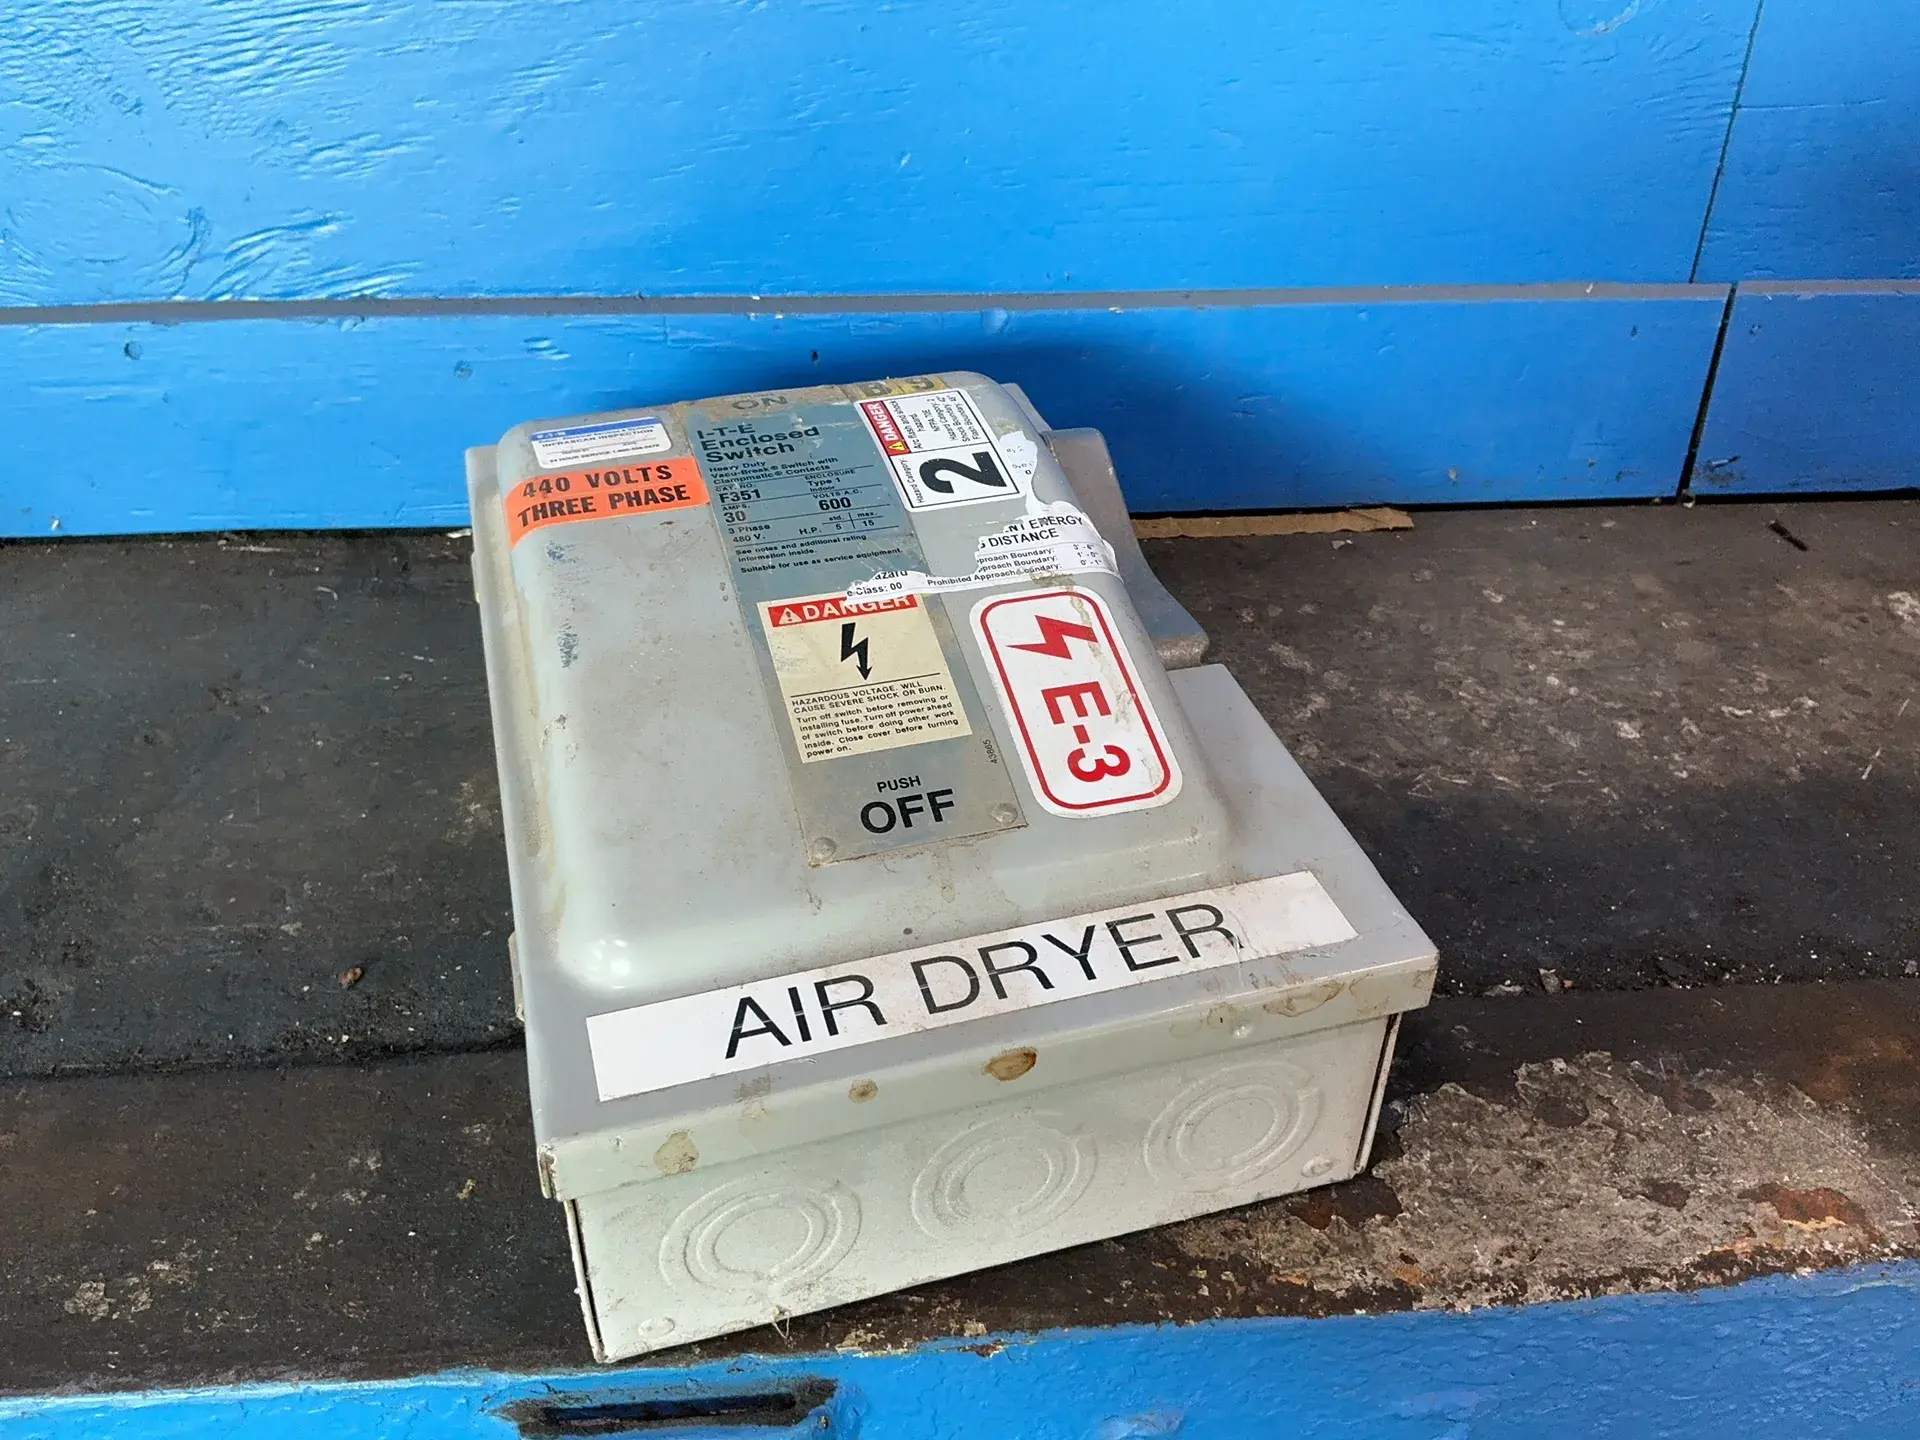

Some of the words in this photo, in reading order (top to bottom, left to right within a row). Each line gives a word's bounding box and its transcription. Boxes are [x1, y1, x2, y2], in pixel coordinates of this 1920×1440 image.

[731, 396, 788, 409] ON
[886, 400, 903, 414] shock
[867, 402, 899, 442] DANGER
[895, 414, 909, 425] and
[926, 418, 941, 432] NFPA
[598, 429, 654, 440] INSPECTION
[697, 423, 756, 440] I-T-E
[701, 426, 820, 451] Enclosed
[902, 425, 917, 438] flash
[941, 423, 958, 441] Hazard
[955, 426, 970, 441] Shock
[966, 425, 981, 439] Flash
[909, 438, 923, 449] Arc
[706, 442, 795, 463] Switch
[709, 463, 739, 473] Heavy
[742, 461, 766, 469] Duty
[781, 460, 815, 470] Switch
[817, 457, 838, 465] with
[785, 465, 831, 475] Contacts
[900, 457, 916, 483] Category:
[804, 469, 856, 480] ENCLOSURE
[919, 451, 1007, 494] 2
[522, 477, 570, 498] 440
[585, 465, 672, 489] VOLTS
[807, 479, 832, 487] Type
[719, 489, 761, 503] F351
[908, 483, 926, 503] Hazard
[517, 496, 597, 528] THREE
[608, 484, 691, 510] PHASE
[818, 497, 852, 511] 600
[724, 510, 747, 523] 30
[1028, 515, 1081, 529] ENERGY
[738, 524, 771, 533] Phase
[799, 527, 822, 535] H.P.
[862, 519, 875, 527] 15
[733, 535, 751, 543] 480
[755, 545, 778, 553] notes
[800, 537, 840, 547] additional
[843, 535, 867, 543] rating
[988, 528, 1059, 547] DISTANCE
[738, 552, 786, 562] information
[789, 548, 817, 556] inside.
[741, 565, 776, 573] Suitable
[856, 548, 903, 559] equipment.
[1010, 547, 1055, 559] Boundary:
[1014, 555, 1058, 567] Boundary:
[927, 575, 972, 586] Prohibited
[974, 569, 1016, 581] Approach
[856, 585, 888, 596] Class:
[889, 581, 903, 591] 00
[792, 692, 850, 706] HAZARDOUS
[852, 685, 898, 697] VOLTAGE.
[900, 681, 923, 689] WILL
[794, 704, 826, 714] CAUSE
[829, 697, 864, 708] SEVERE
[867, 692, 899, 702] SHOCK
[918, 685, 946, 694] BURN.
[834, 709, 862, 718] switch
[866, 704, 893, 713] before
[897, 697, 936, 707] removing
[800, 721, 839, 732] installing
[841, 718, 863, 726] fuse.
[899, 707, 924, 717] power
[927, 702, 952, 711] ahead
[815, 729, 843, 738] switch
[846, 723, 874, 733] before
[879, 720, 903, 728] doing
[907, 715, 930, 723] other
[934, 710, 954, 718] work
[804, 741, 834, 749] inside.
[839, 735, 863, 744] Close
[868, 730, 890, 739] cover
[895, 725, 923, 734] before
[928, 719, 959, 728] turning
[1041, 681, 1131, 783] E-3
[807, 748, 833, 758] power
[876, 775, 921, 793] PUSH
[860, 788, 954, 834] OFF
[725, 974, 888, 1060] AIR
[910, 903, 1246, 1015] DRYER
